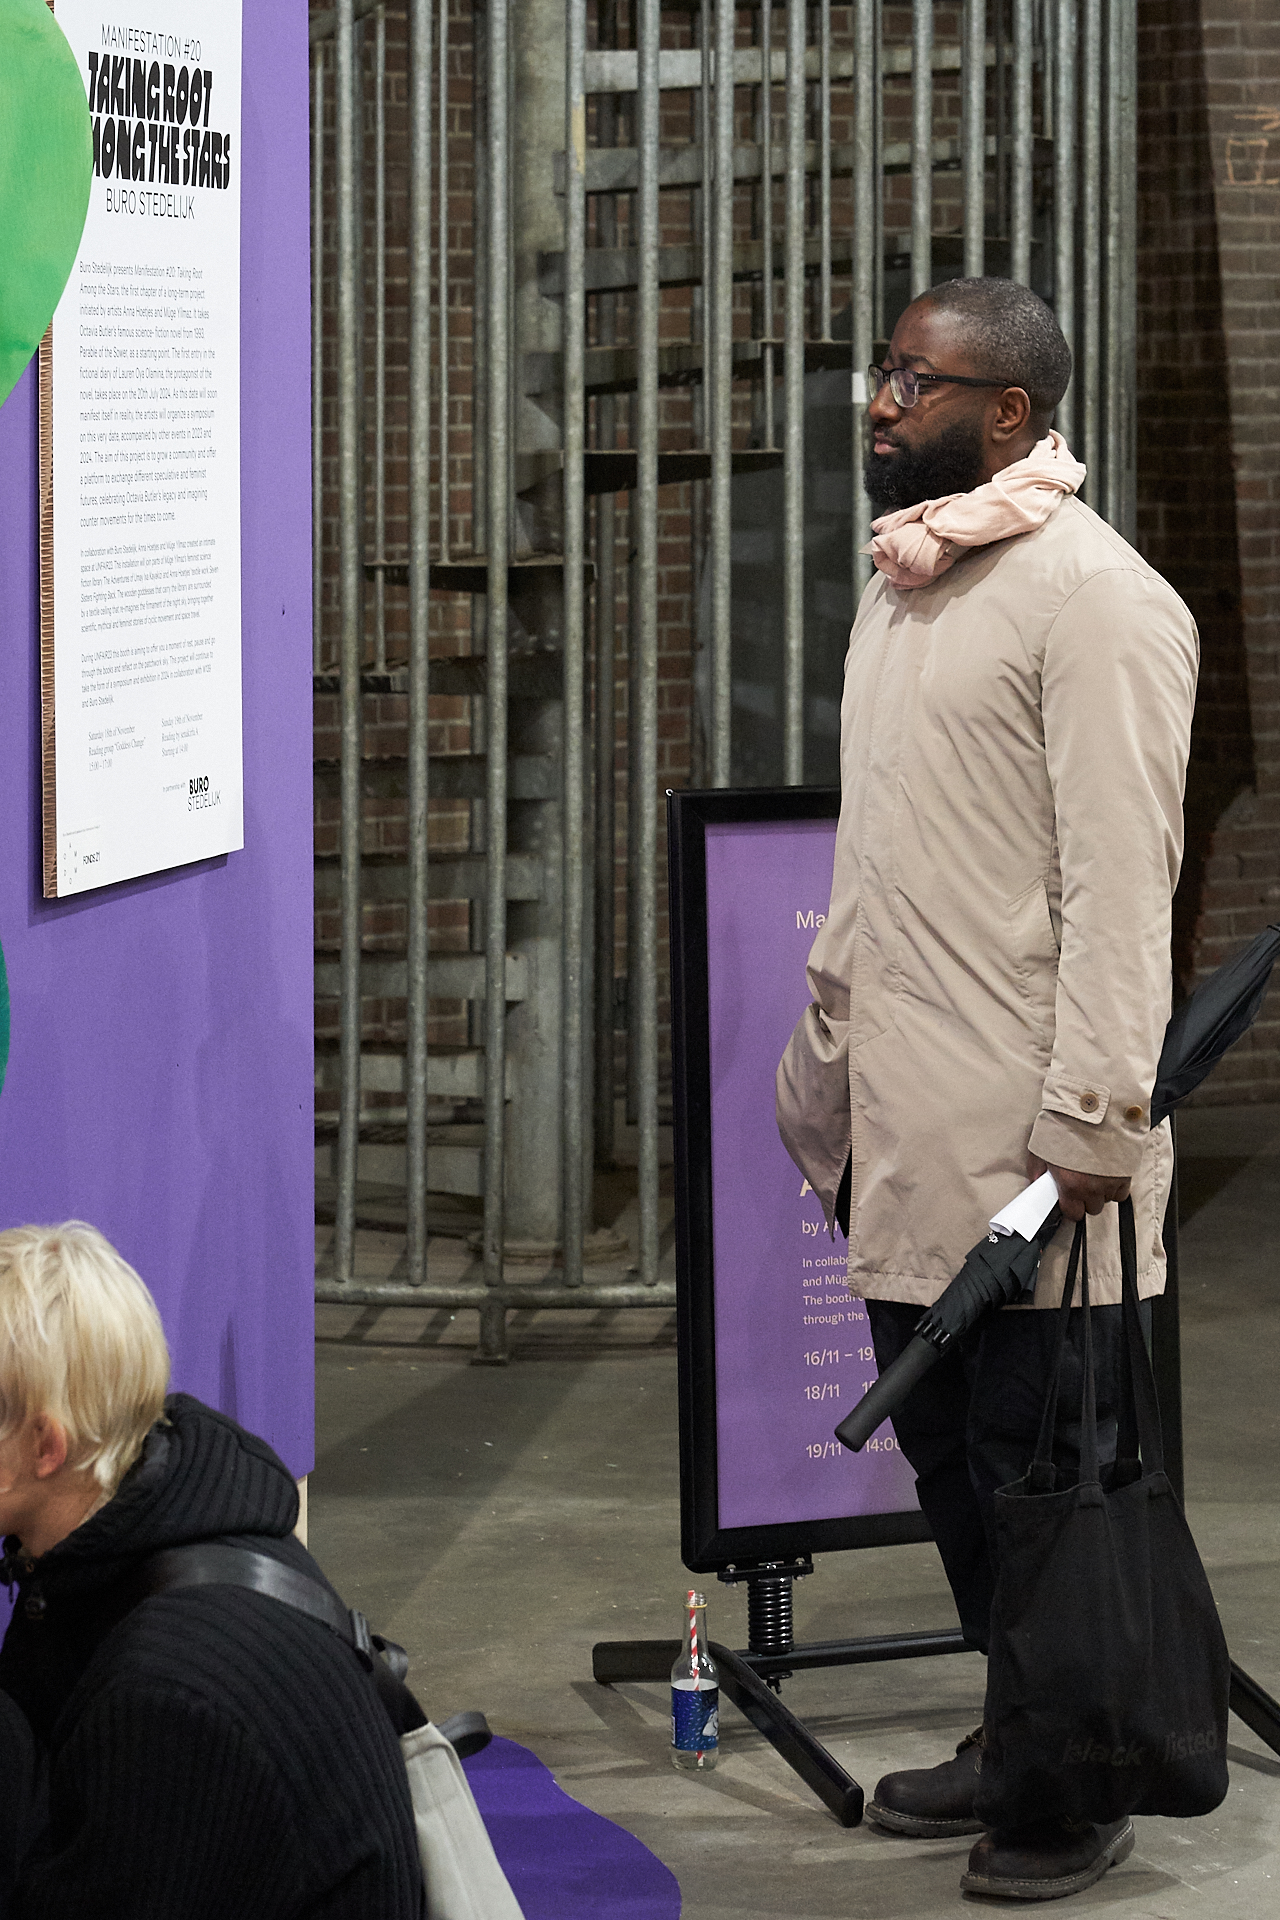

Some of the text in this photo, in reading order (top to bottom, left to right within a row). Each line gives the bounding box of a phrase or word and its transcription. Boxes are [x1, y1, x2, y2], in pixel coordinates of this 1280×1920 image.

[101, 23, 202, 61] MANIFESTATION #20
[88, 51, 213, 127] TAKING ROOT
[149, 123, 180, 185] THE
[183, 128, 231, 190] STARS
[106, 188, 195, 219] BURO STEDELIJK
[189, 776, 209, 795] BURO
[188, 790, 221, 811] STEDELIJK
[796, 910, 827, 929] Ma
[802, 1220, 820, 1237] by
[802, 1258, 812, 1268] In
[802, 1276, 821, 1287] and
[803, 1295, 822, 1306] The
[803, 1311, 864, 1325] through the
[803, 1349, 839, 1367] 16/11
[804, 1383, 840, 1401] 18/11
[806, 1441, 842, 1459] 19/11
